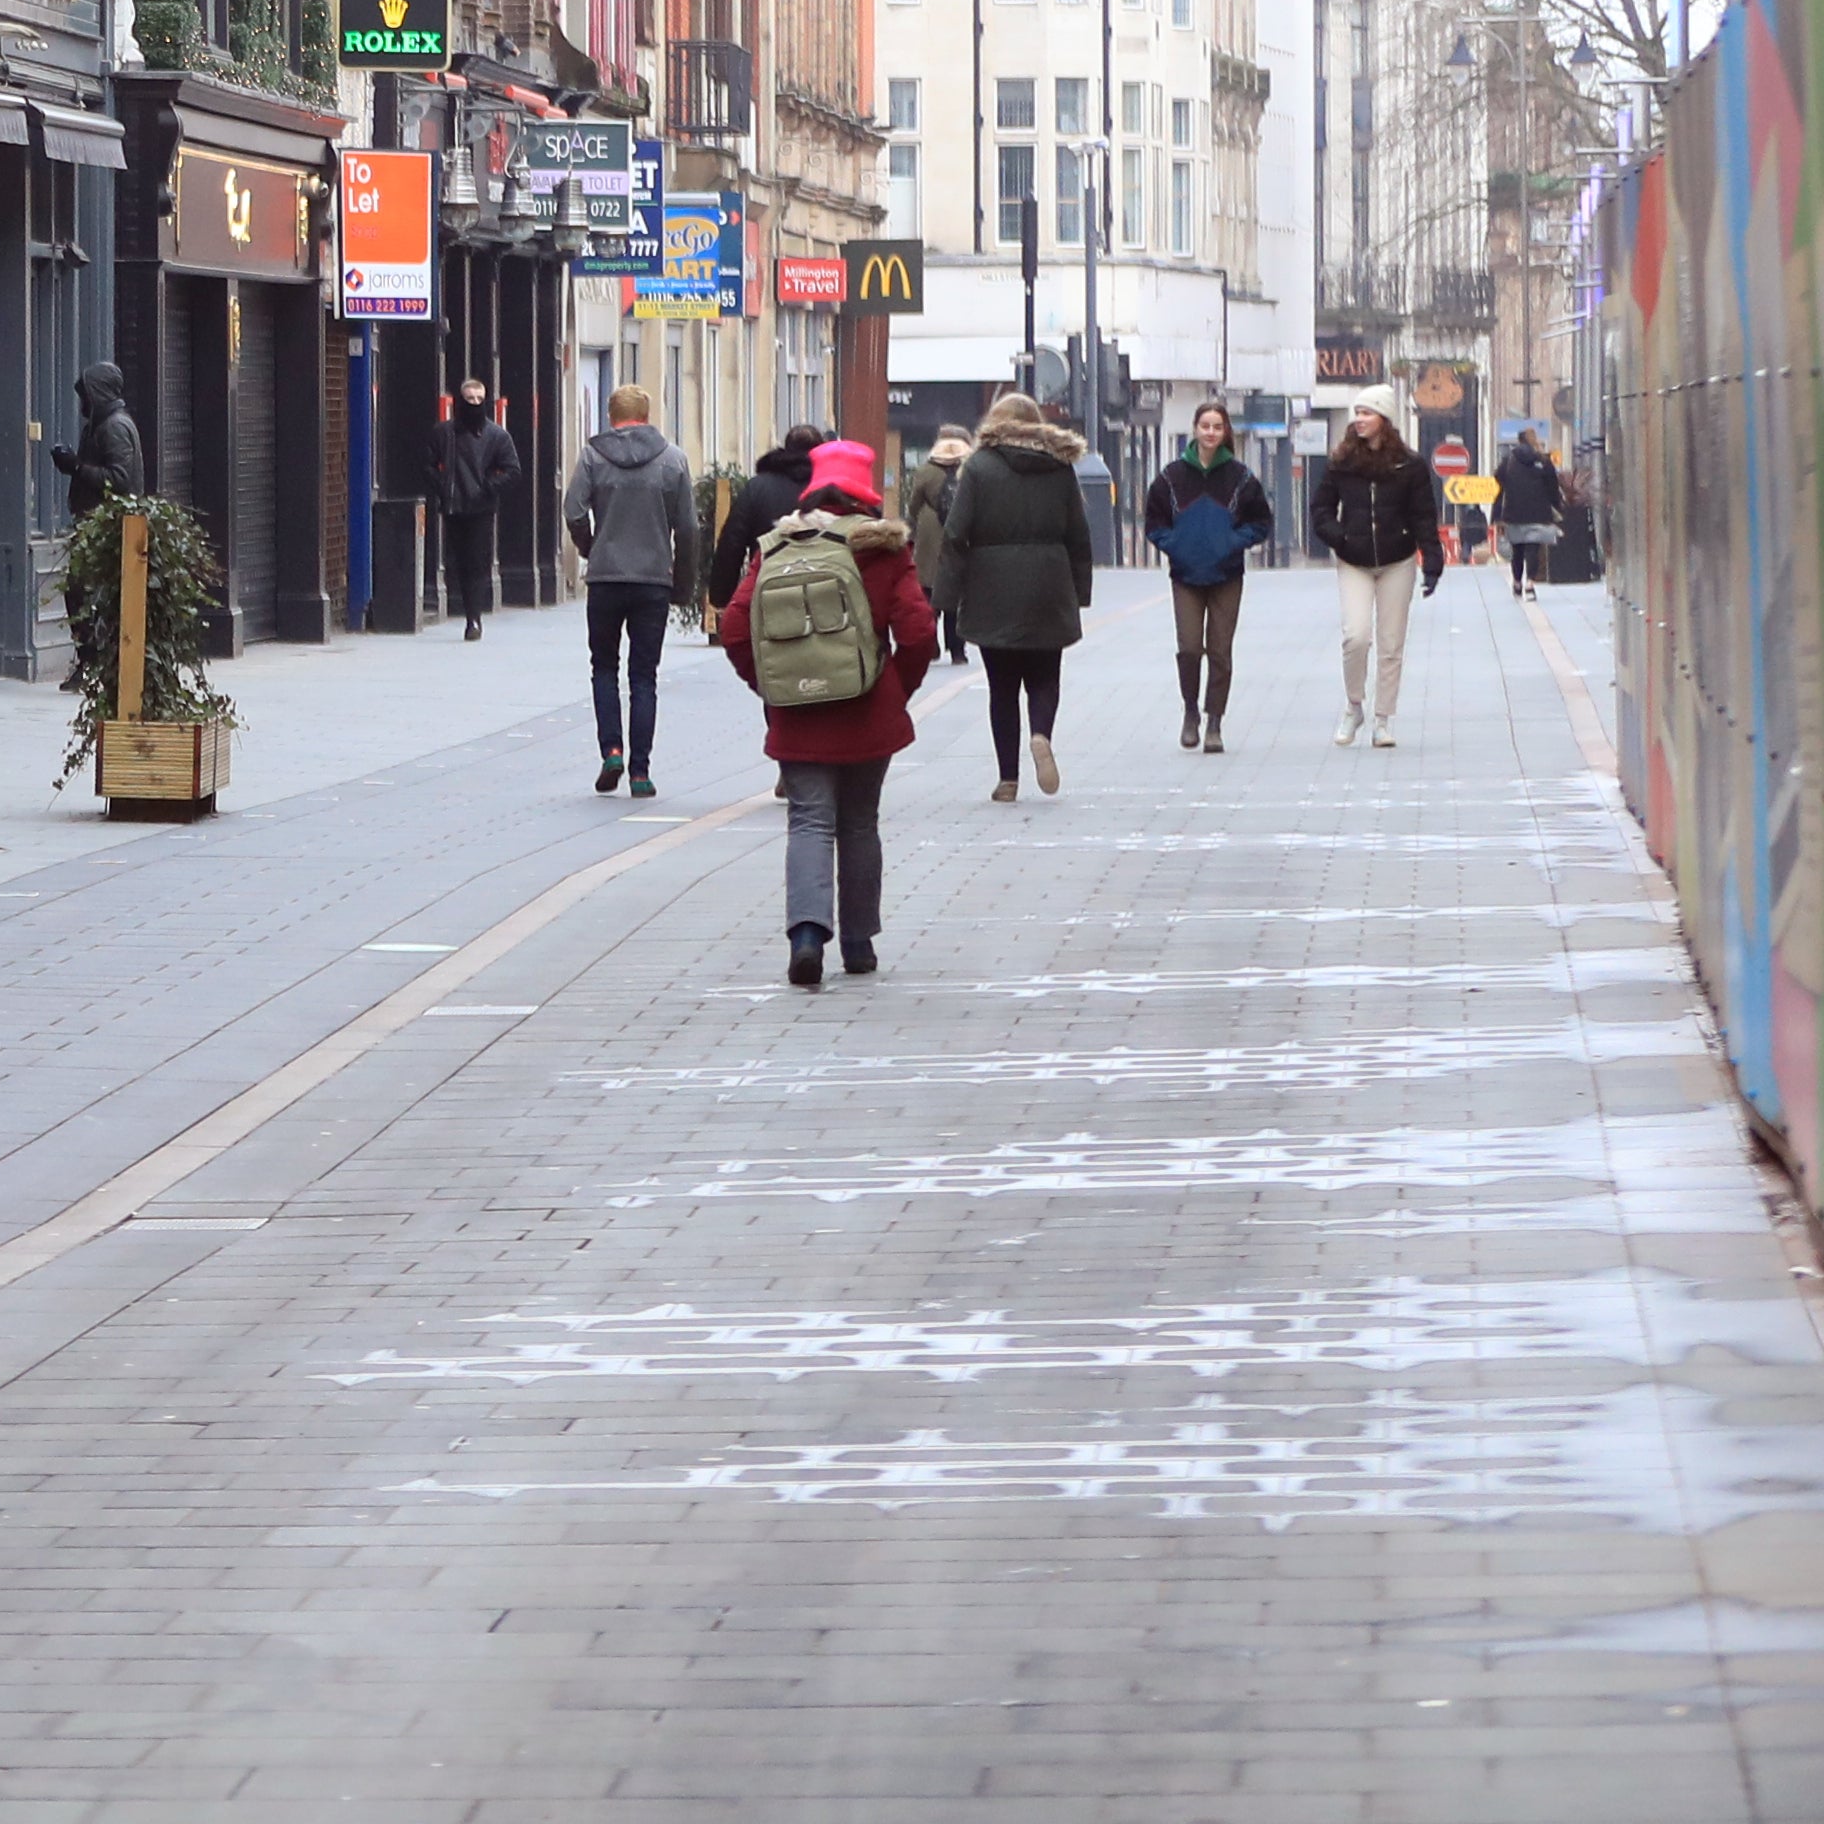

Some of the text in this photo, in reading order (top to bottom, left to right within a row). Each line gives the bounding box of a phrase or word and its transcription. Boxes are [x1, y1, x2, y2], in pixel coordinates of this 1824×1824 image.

[344, 30, 444, 54] ROLEX
[347, 158, 372, 184] To
[349, 187, 379, 214] Let
[591, 201, 621, 218] 0722
[630, 239, 658, 256] 7777
[368, 270, 424, 292] jarroms
[784, 266, 839, 280] Millington
[793, 278, 839, 293] Travel
[348, 299, 426, 313] 0116 222 1999
[1317, 350, 1379, 376] RIARY
